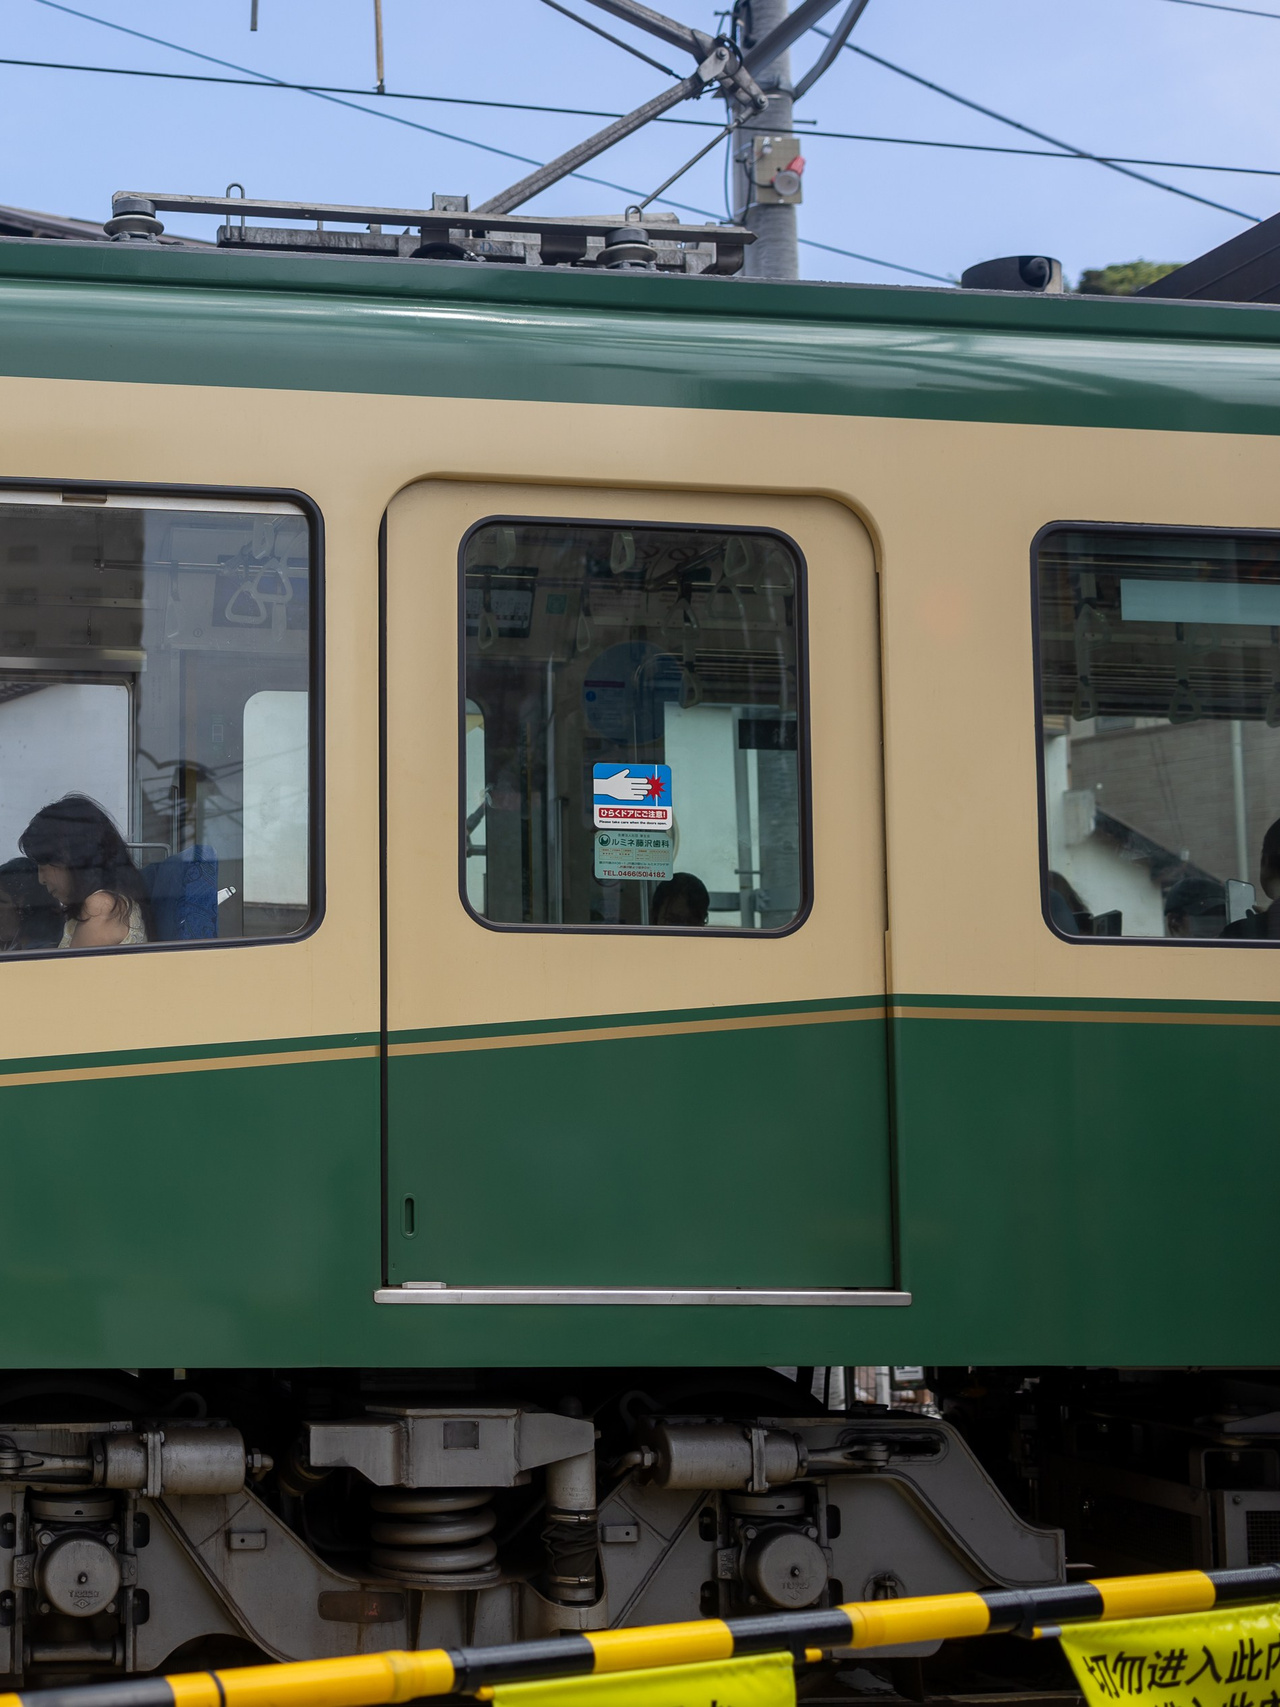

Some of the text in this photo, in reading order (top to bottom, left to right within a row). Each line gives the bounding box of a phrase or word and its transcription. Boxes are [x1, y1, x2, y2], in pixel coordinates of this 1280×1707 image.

[611, 838, 669, 848] ルミネ藤沢歯科
